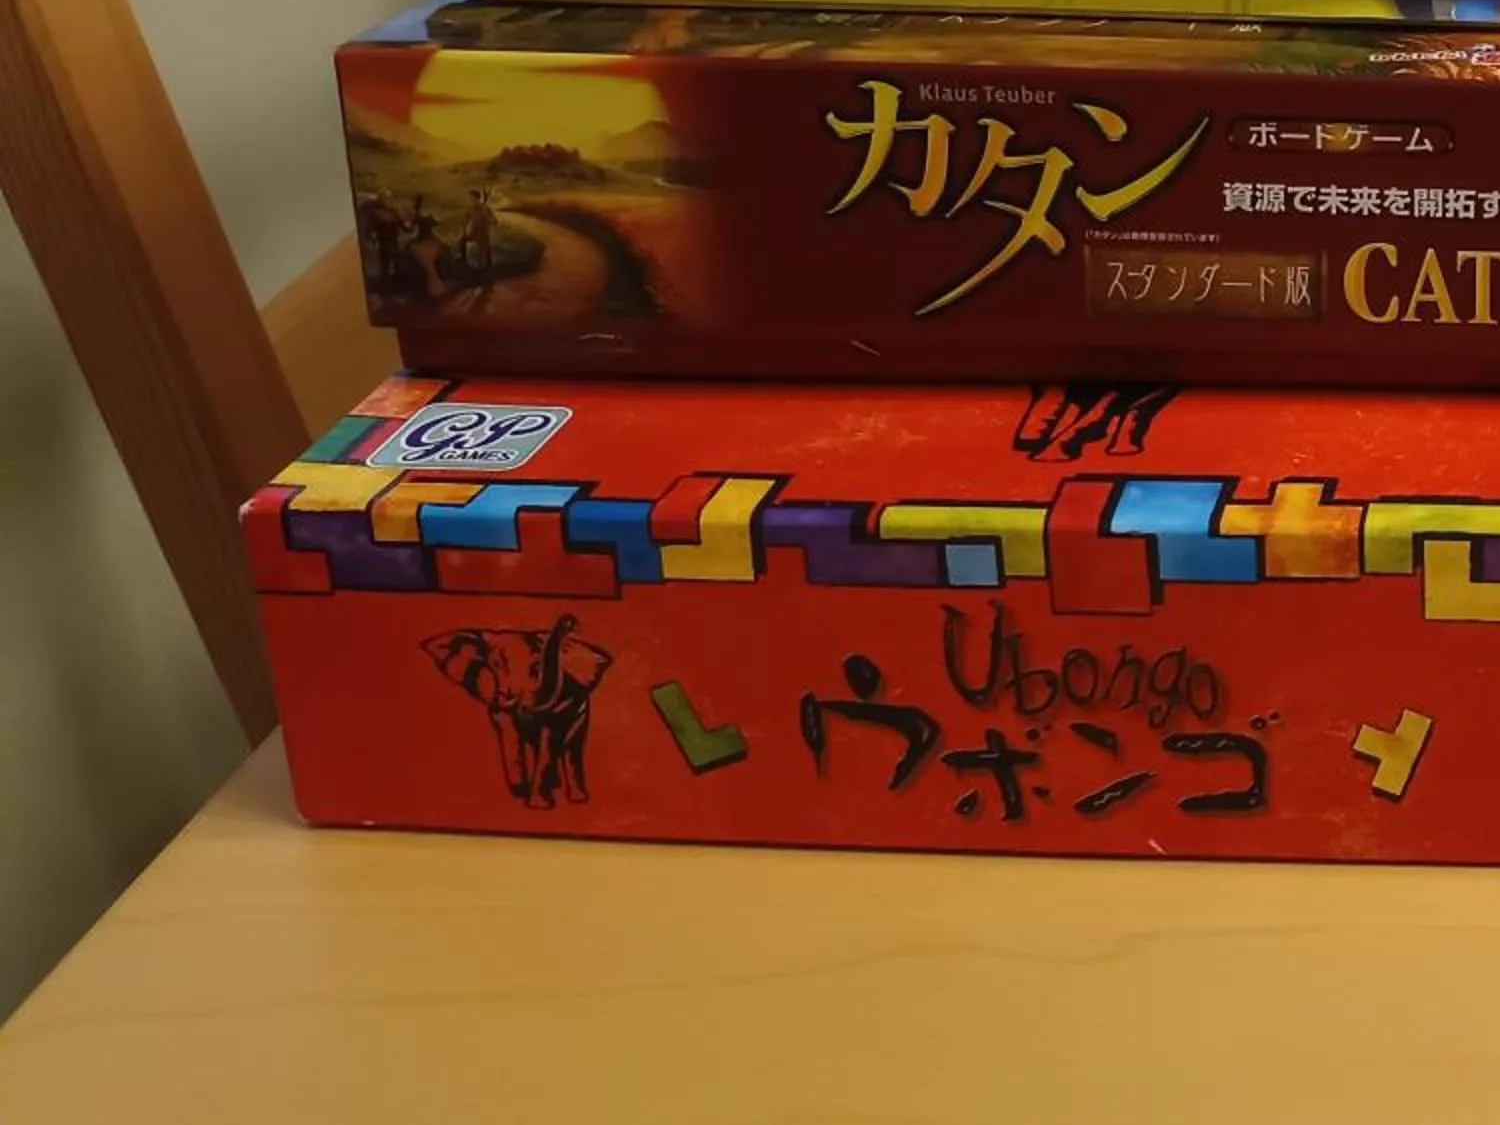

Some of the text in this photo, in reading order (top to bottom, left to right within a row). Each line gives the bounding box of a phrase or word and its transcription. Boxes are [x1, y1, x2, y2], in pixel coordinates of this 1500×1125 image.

[919, 82, 1057, 105] Klaus Teuber
[1248, 122, 1435, 154] ボードゲーム
[825, 80, 1210, 316] カタン
[1107, 262, 1311, 306] スタンダード版
[438, 449, 516, 463] GAMES
[941, 599, 1220, 729] Ubongo
[800, 654, 1283, 822] ウボンゴ
